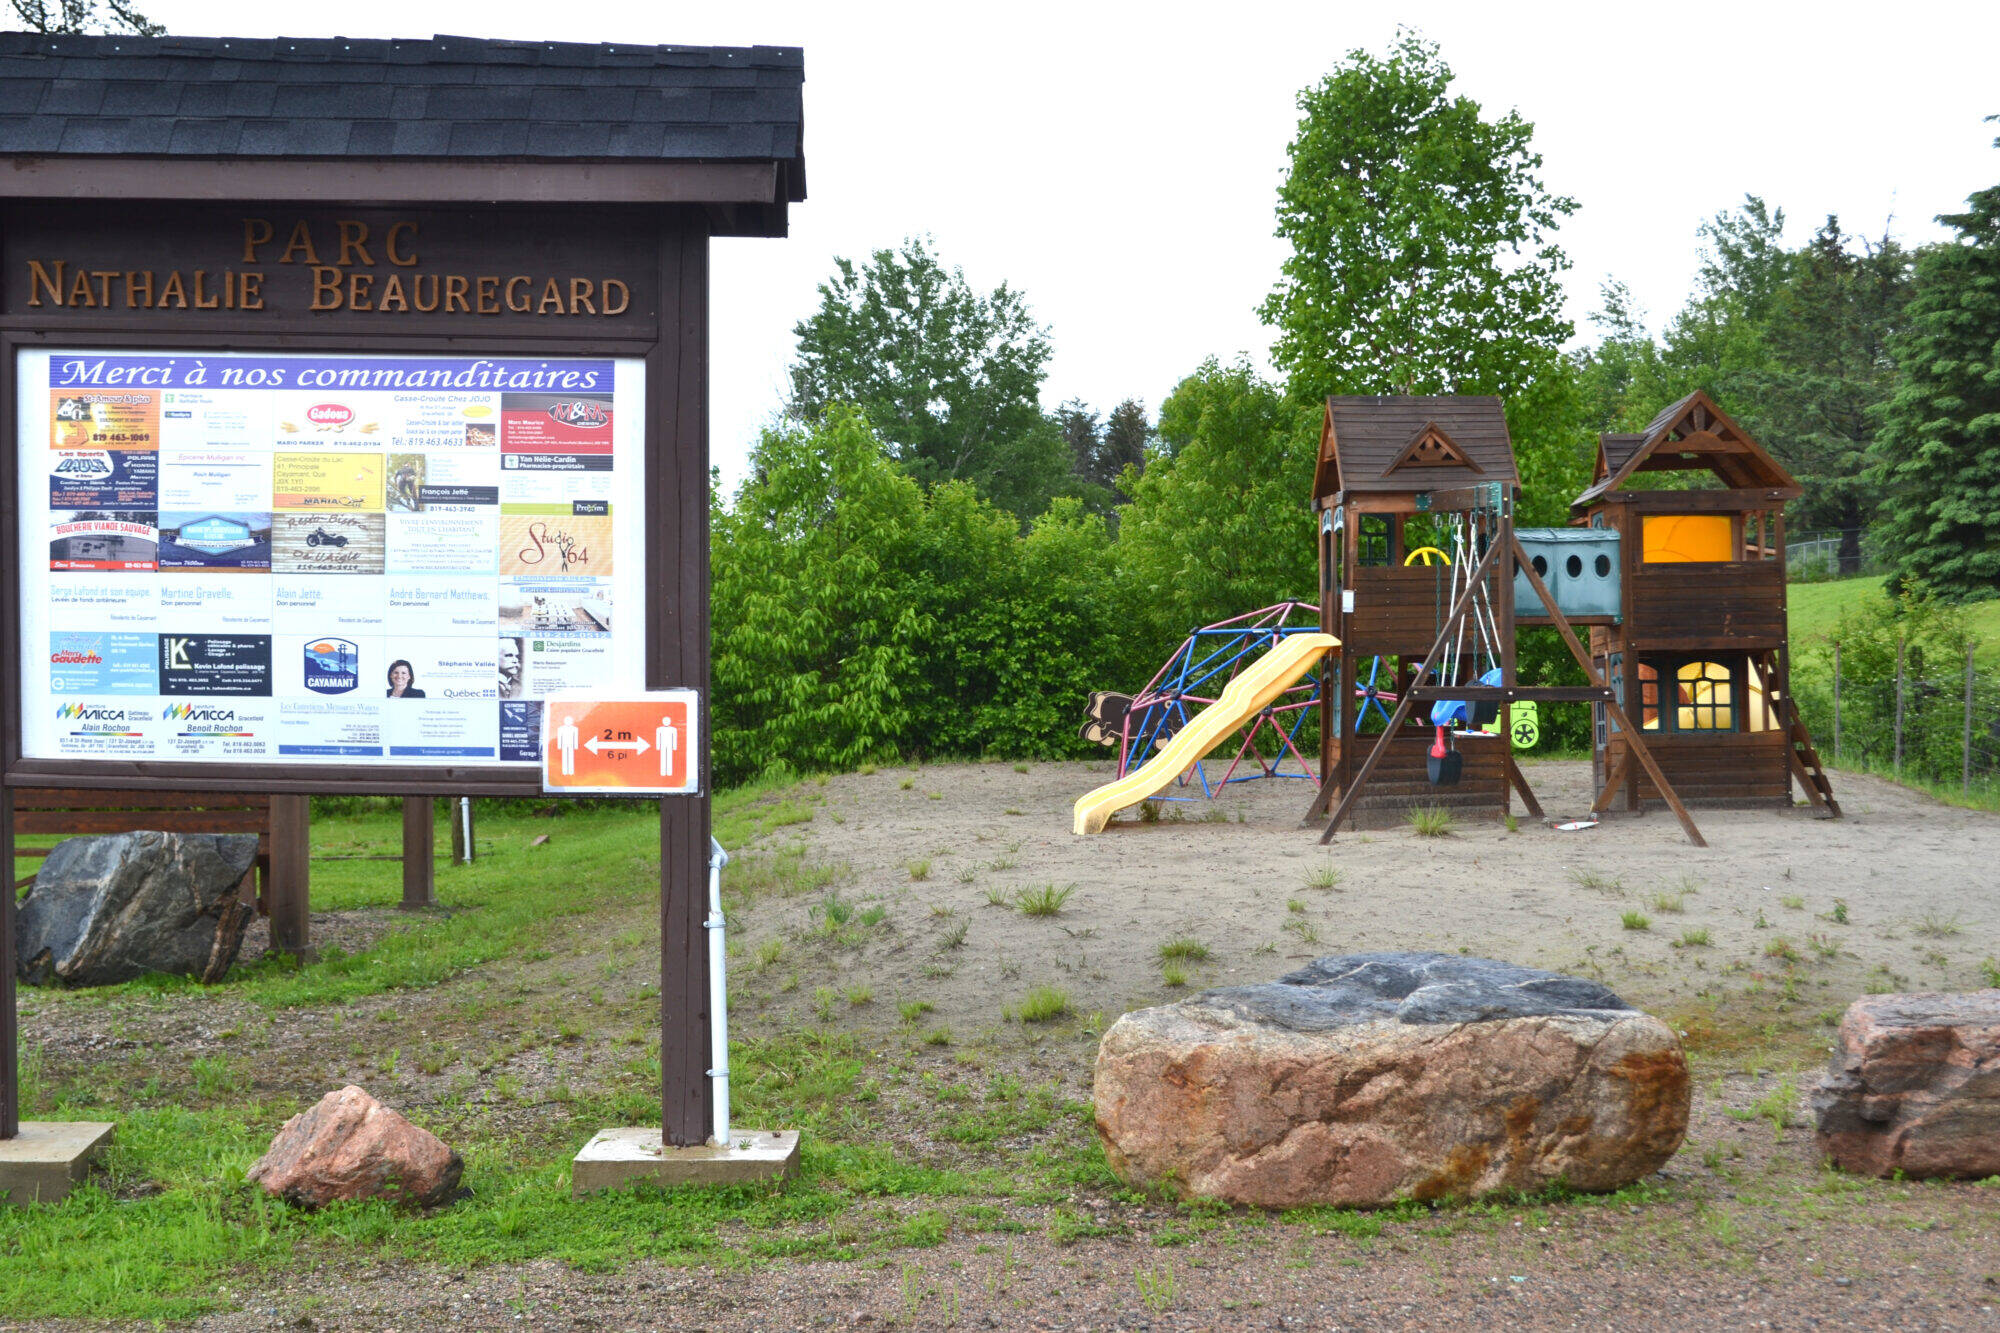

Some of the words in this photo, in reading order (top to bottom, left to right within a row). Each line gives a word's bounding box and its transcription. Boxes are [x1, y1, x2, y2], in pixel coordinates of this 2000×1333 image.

[242, 218, 420, 267] PARC
[27, 259, 265, 311] NATHALIE
[307, 265, 631, 316] BEAUREGARD
[59, 359, 176, 385] Merci
[184, 360, 208, 386] à
[220, 367, 287, 387] nos
[296, 360, 600, 390] commanditaires
[92, 433, 107, 442] 819
[94, 522, 118, 532] VIANDE
[120, 522, 151, 536] SAUVAGE
[566, 544, 589, 564] 64
[308, 678, 354, 688] CAYAMANT
[444, 688, 481, 698] Québec
[77, 710, 125, 720] MICCA
[184, 710, 234, 721] MICCA
[82, 723, 100, 732] Alain
[102, 724, 130, 732] Rochon
[214, 724, 243, 732] Rochon
[604, 729, 613, 740] 2
[617, 732, 632, 740] m
[607, 751, 614, 760] 6
[618, 751, 628, 760] pi
